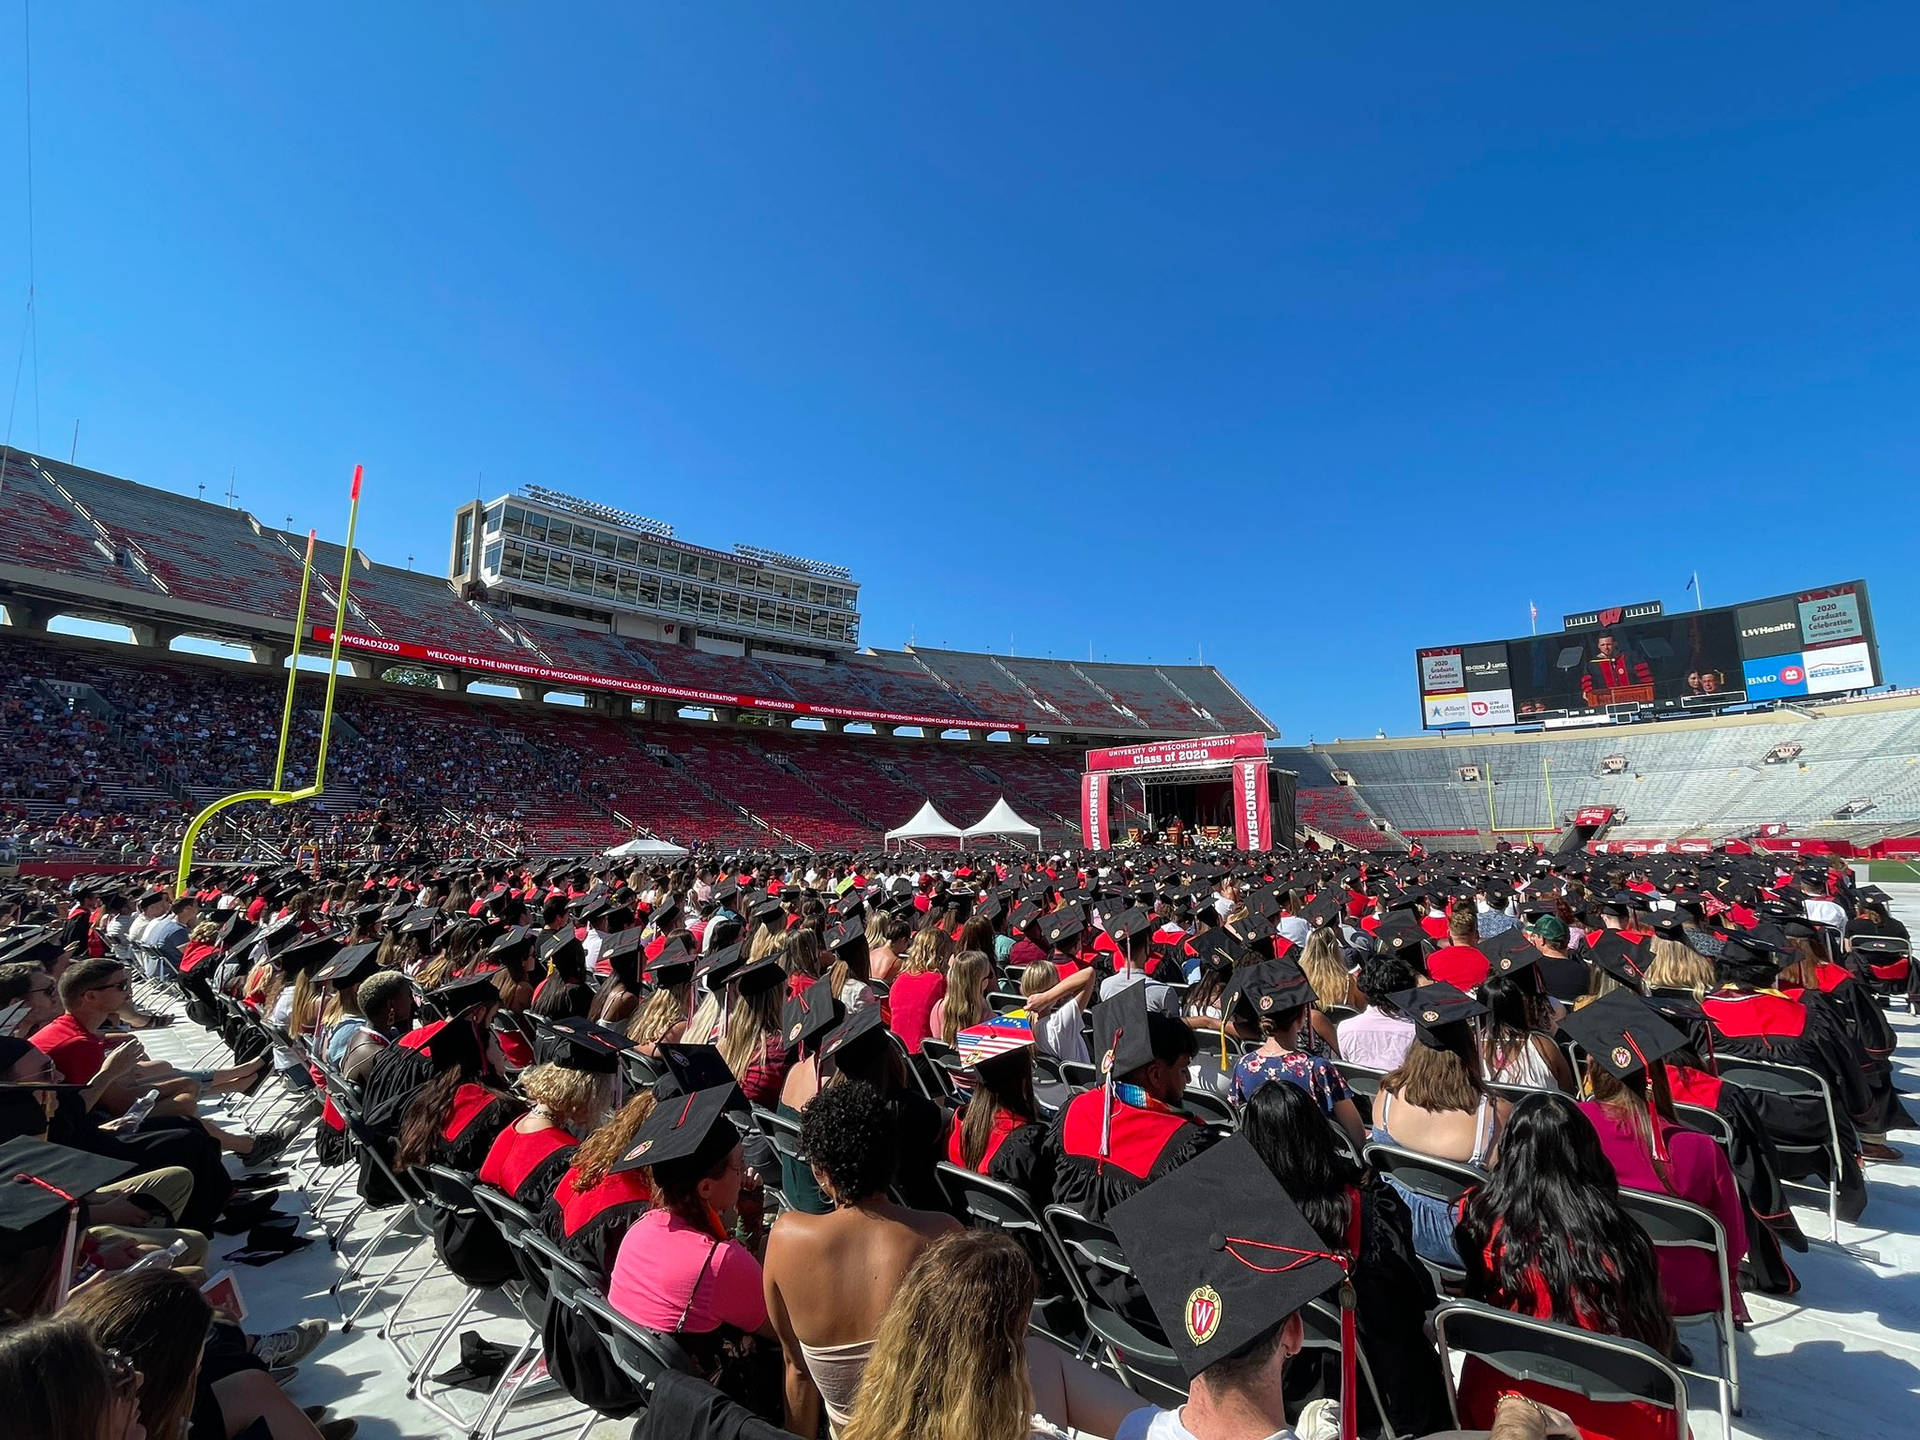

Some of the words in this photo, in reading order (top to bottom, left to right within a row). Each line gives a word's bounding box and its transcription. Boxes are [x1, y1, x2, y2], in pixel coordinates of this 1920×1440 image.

[671, 541, 731, 560] COMMUNICATIONS
[733, 556, 758, 567] CENTER
[1817, 603, 1837, 612] 2020
[1808, 619, 1853, 630] Celebration
[1811, 611, 1847, 622] Graduate
[426, 650, 466, 664] WELCOME
[468, 657, 479, 665] TO
[481, 659, 495, 668] THE
[497, 662, 539, 674] UNIVERSITY
[551, 670, 621, 687] WISCONSIN-MADISON
[623, 681, 641, 690] CLASS
[668, 688, 698, 698] GRADUATE
[699, 692, 738, 702] CELEBRATION!
[1748, 674, 1777, 685] BMO
[754, 699, 794, 709] #UWGRAD2020
[810, 706, 834, 714] WELCOME
[852, 710, 879, 718] UNIVERSITY
[1108, 747, 1145, 757] UNIVERSITY
[1159, 738, 1235, 751] WISCONSIN-MADISON
[1133, 755, 1162, 765] Class
[1165, 751, 1176, 762] of
[1179, 749, 1208, 760] 2020
[1090, 775, 1101, 851] WISCONSIN
[1244, 763, 1260, 851] WISCONSIN
[1194, 1301, 1214, 1331] W
